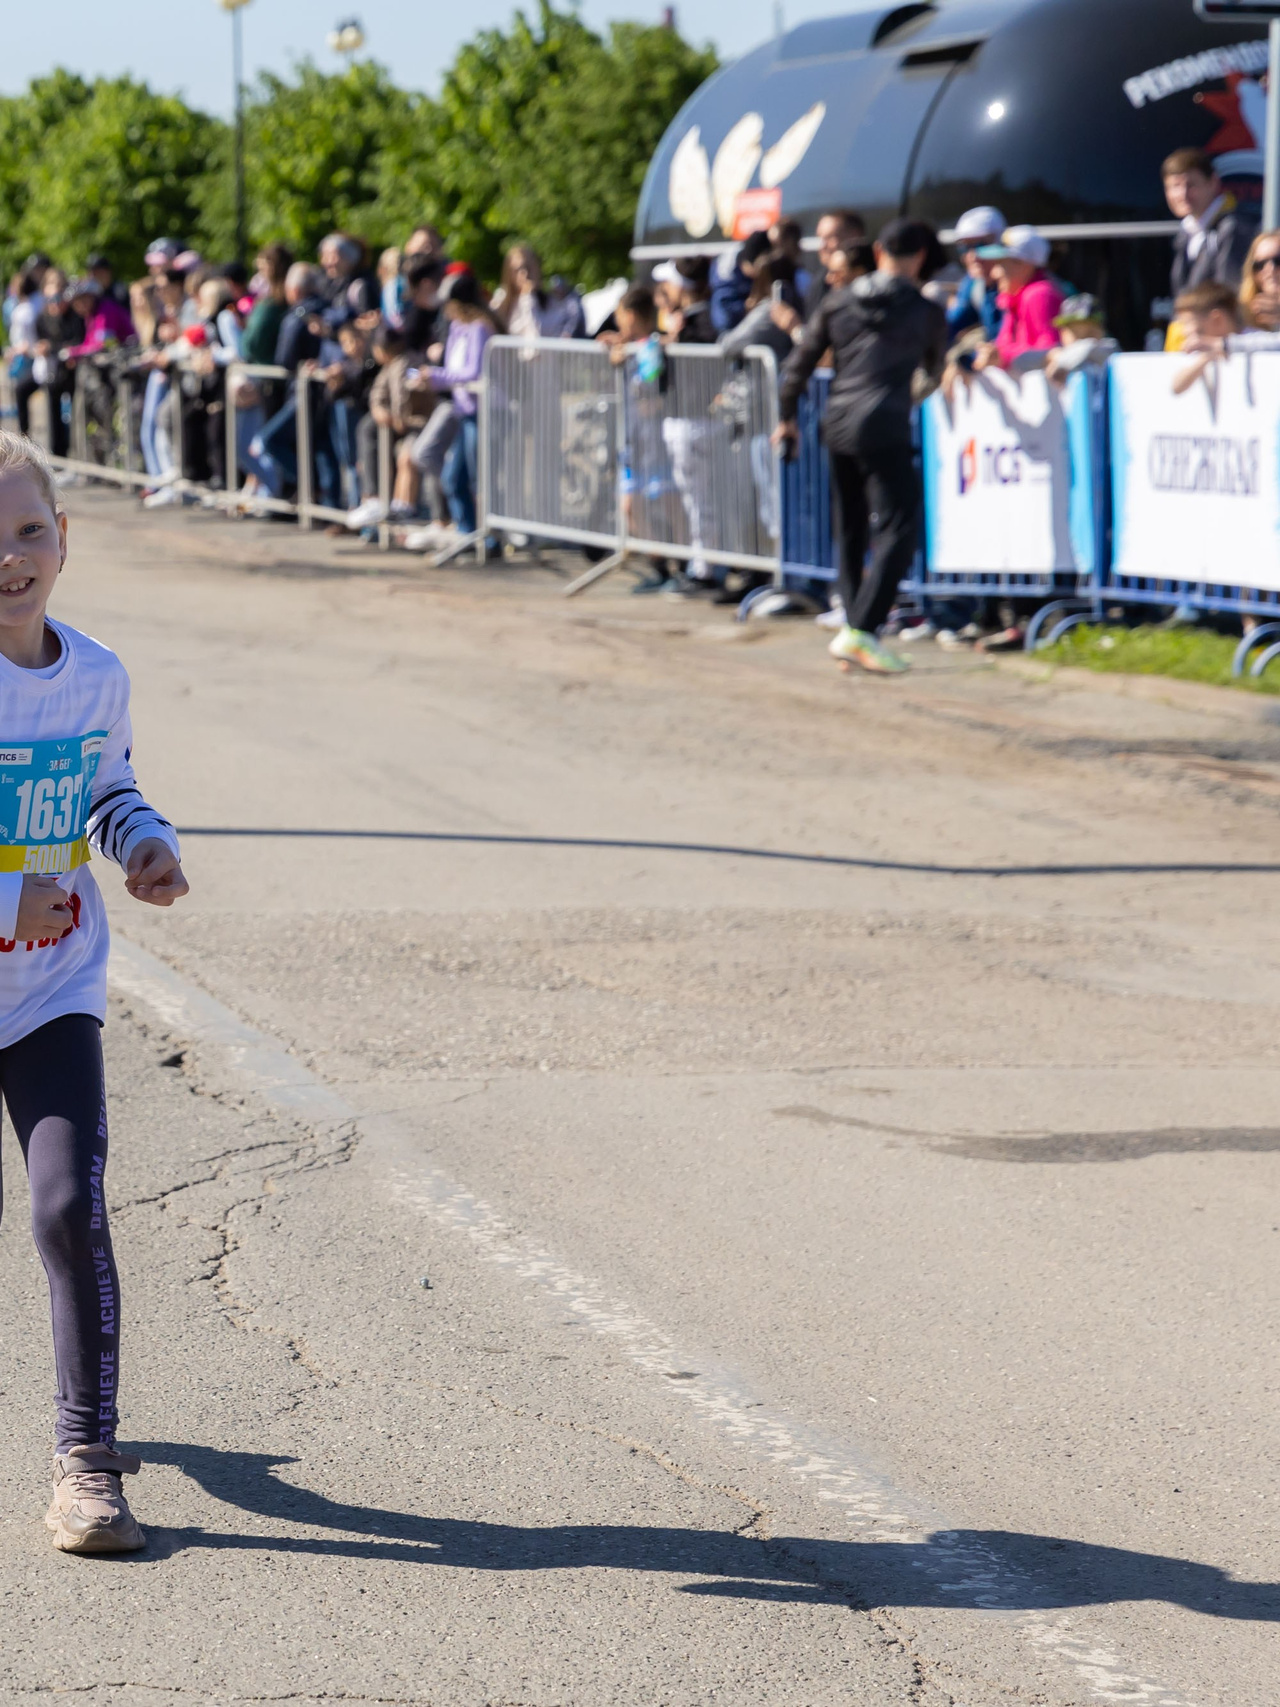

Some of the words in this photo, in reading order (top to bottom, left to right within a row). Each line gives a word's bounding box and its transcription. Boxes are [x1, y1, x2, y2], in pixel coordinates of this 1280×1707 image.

[0, 753, 17, 761] ПСБ
[15, 773, 84, 840] 1637
[90, 1154, 104, 1229] DREAM
[92, 1246, 114, 1335] ACHIEVE
